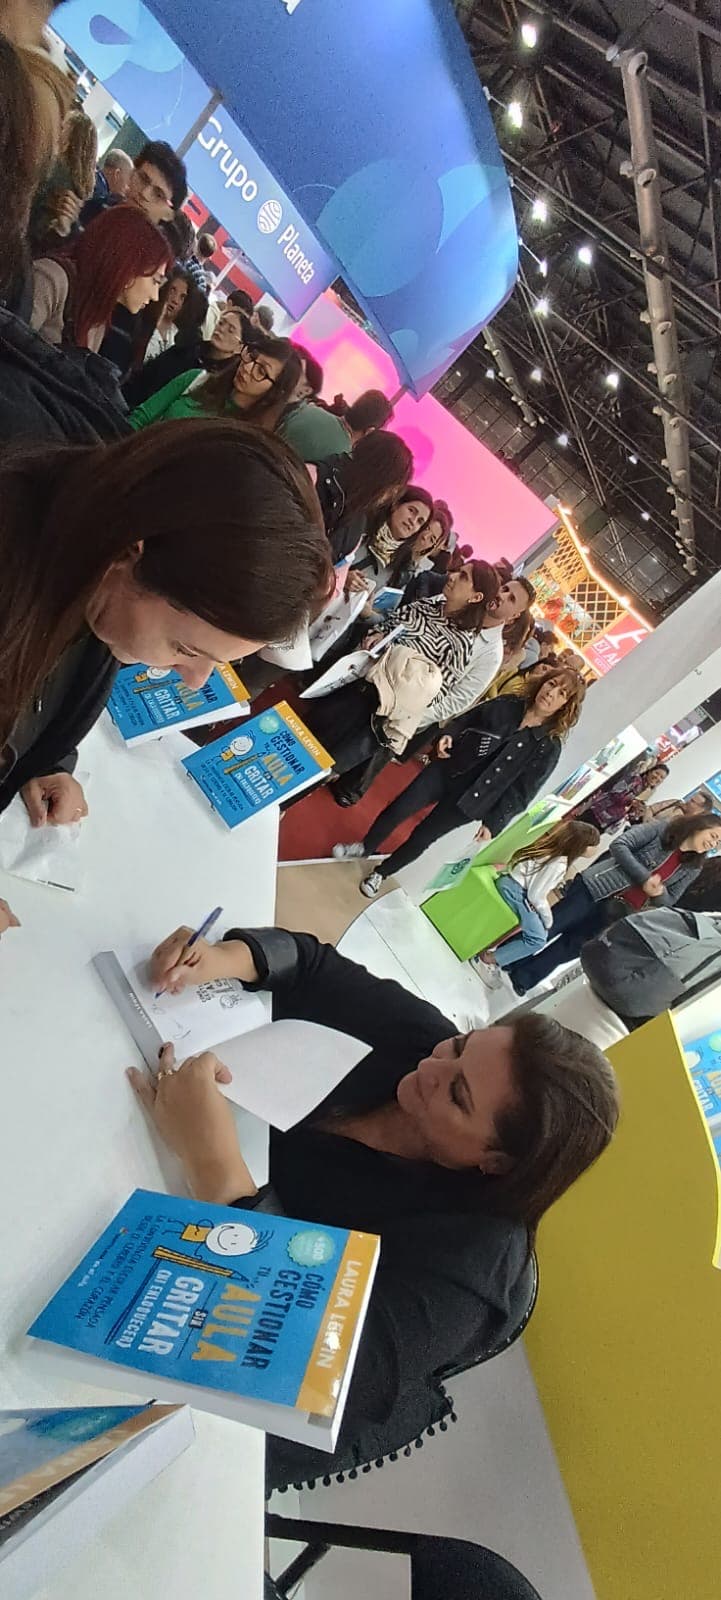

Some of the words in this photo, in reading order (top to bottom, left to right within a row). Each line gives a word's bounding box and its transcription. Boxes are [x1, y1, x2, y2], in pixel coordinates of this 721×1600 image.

[197, 116, 258, 201] Grupo
[277, 224, 315, 284] Planeta
[152, 688, 181, 720] GRITAR
[263, 752, 294, 786] AULA
[270, 735, 305, 775] GESTIONAR
[245, 765, 274, 799] GRITAR
[295, 1272, 326, 1310] CÓMO
[334, 1260, 362, 1308] LAURA
[138, 1276, 204, 1356] GRITAR
[191, 1283, 261, 1362] AULA
[240, 1269, 302, 1370] GESTIONAR
